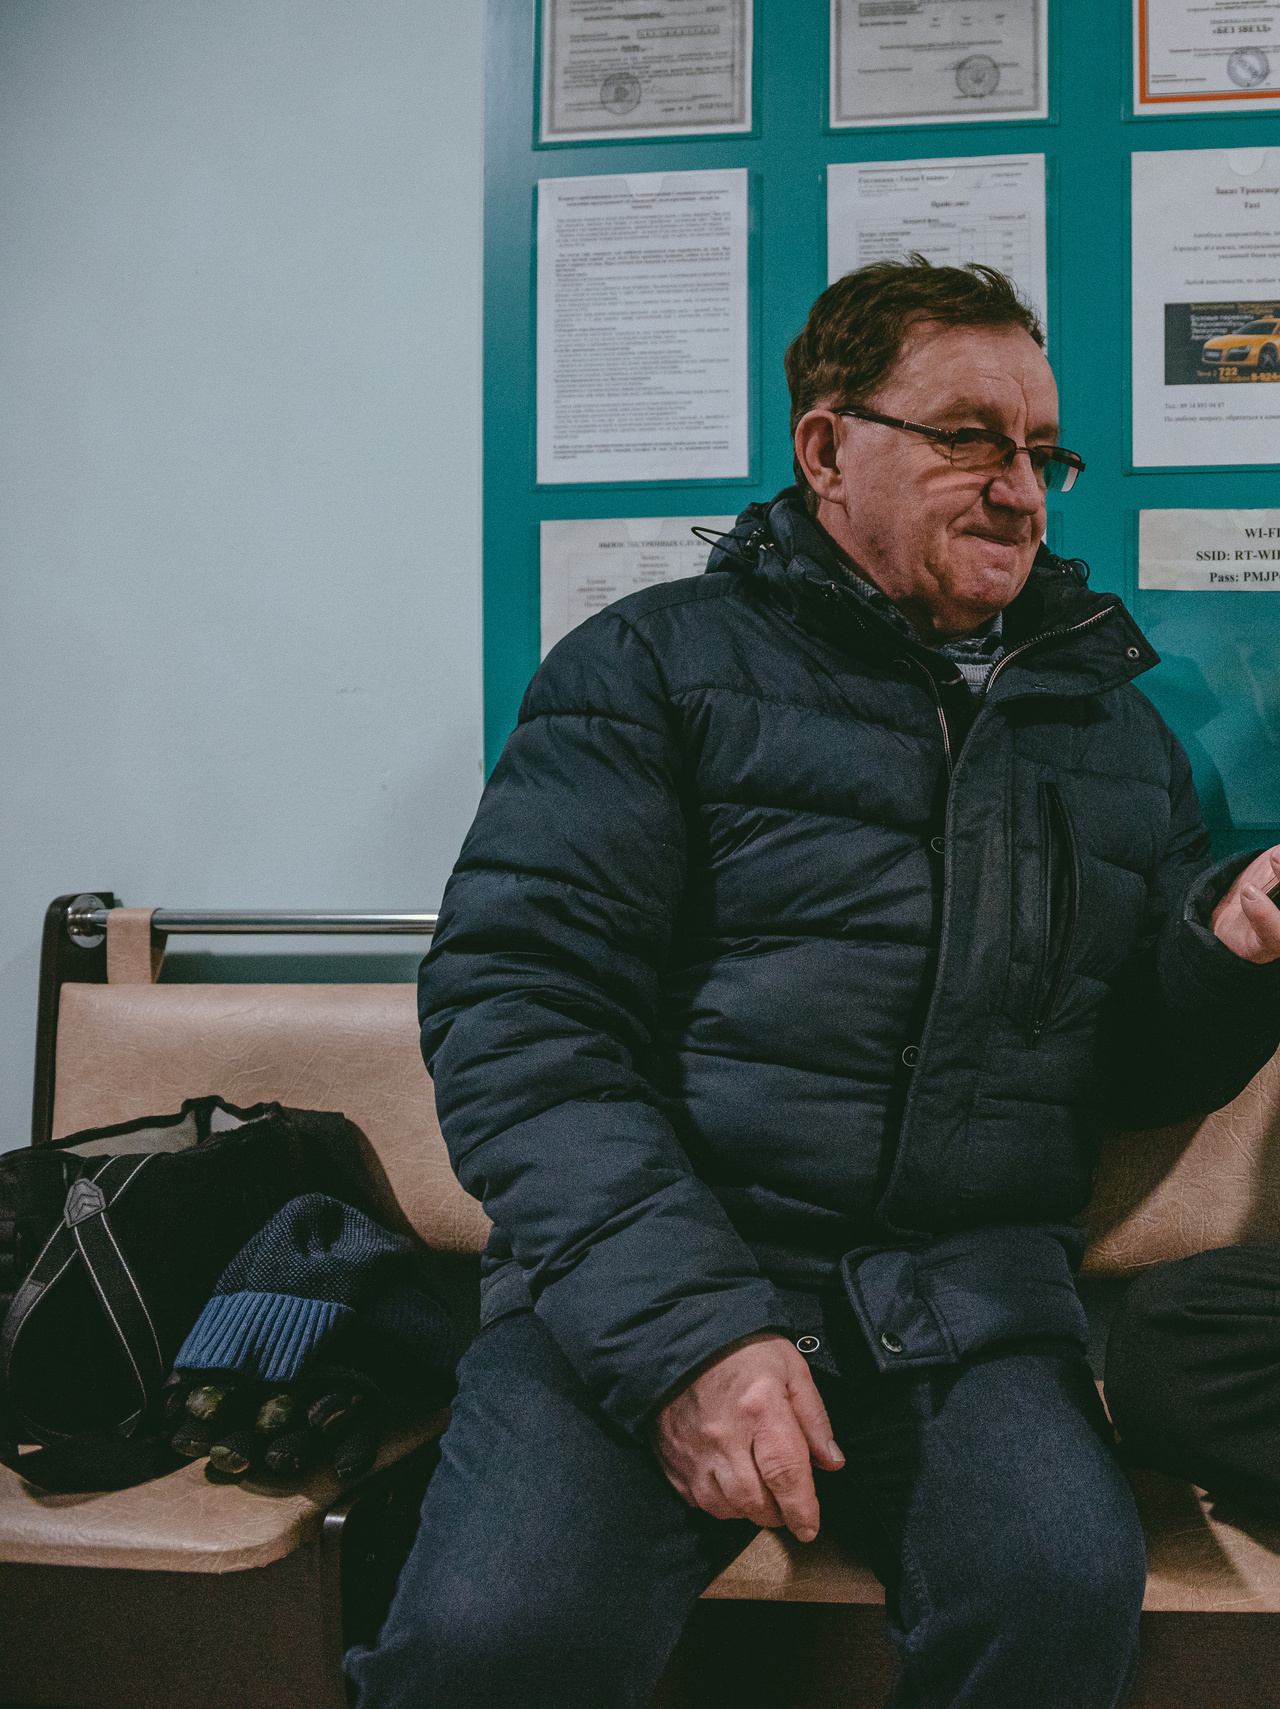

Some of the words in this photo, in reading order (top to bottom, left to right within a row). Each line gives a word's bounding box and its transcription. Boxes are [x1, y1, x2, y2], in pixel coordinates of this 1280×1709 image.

[1219, 366, 1238, 376] 722
[1245, 528, 1280, 538] WI-FI
[1196, 550, 1230, 561] SSID:
[1209, 571, 1239, 582] Pass:
